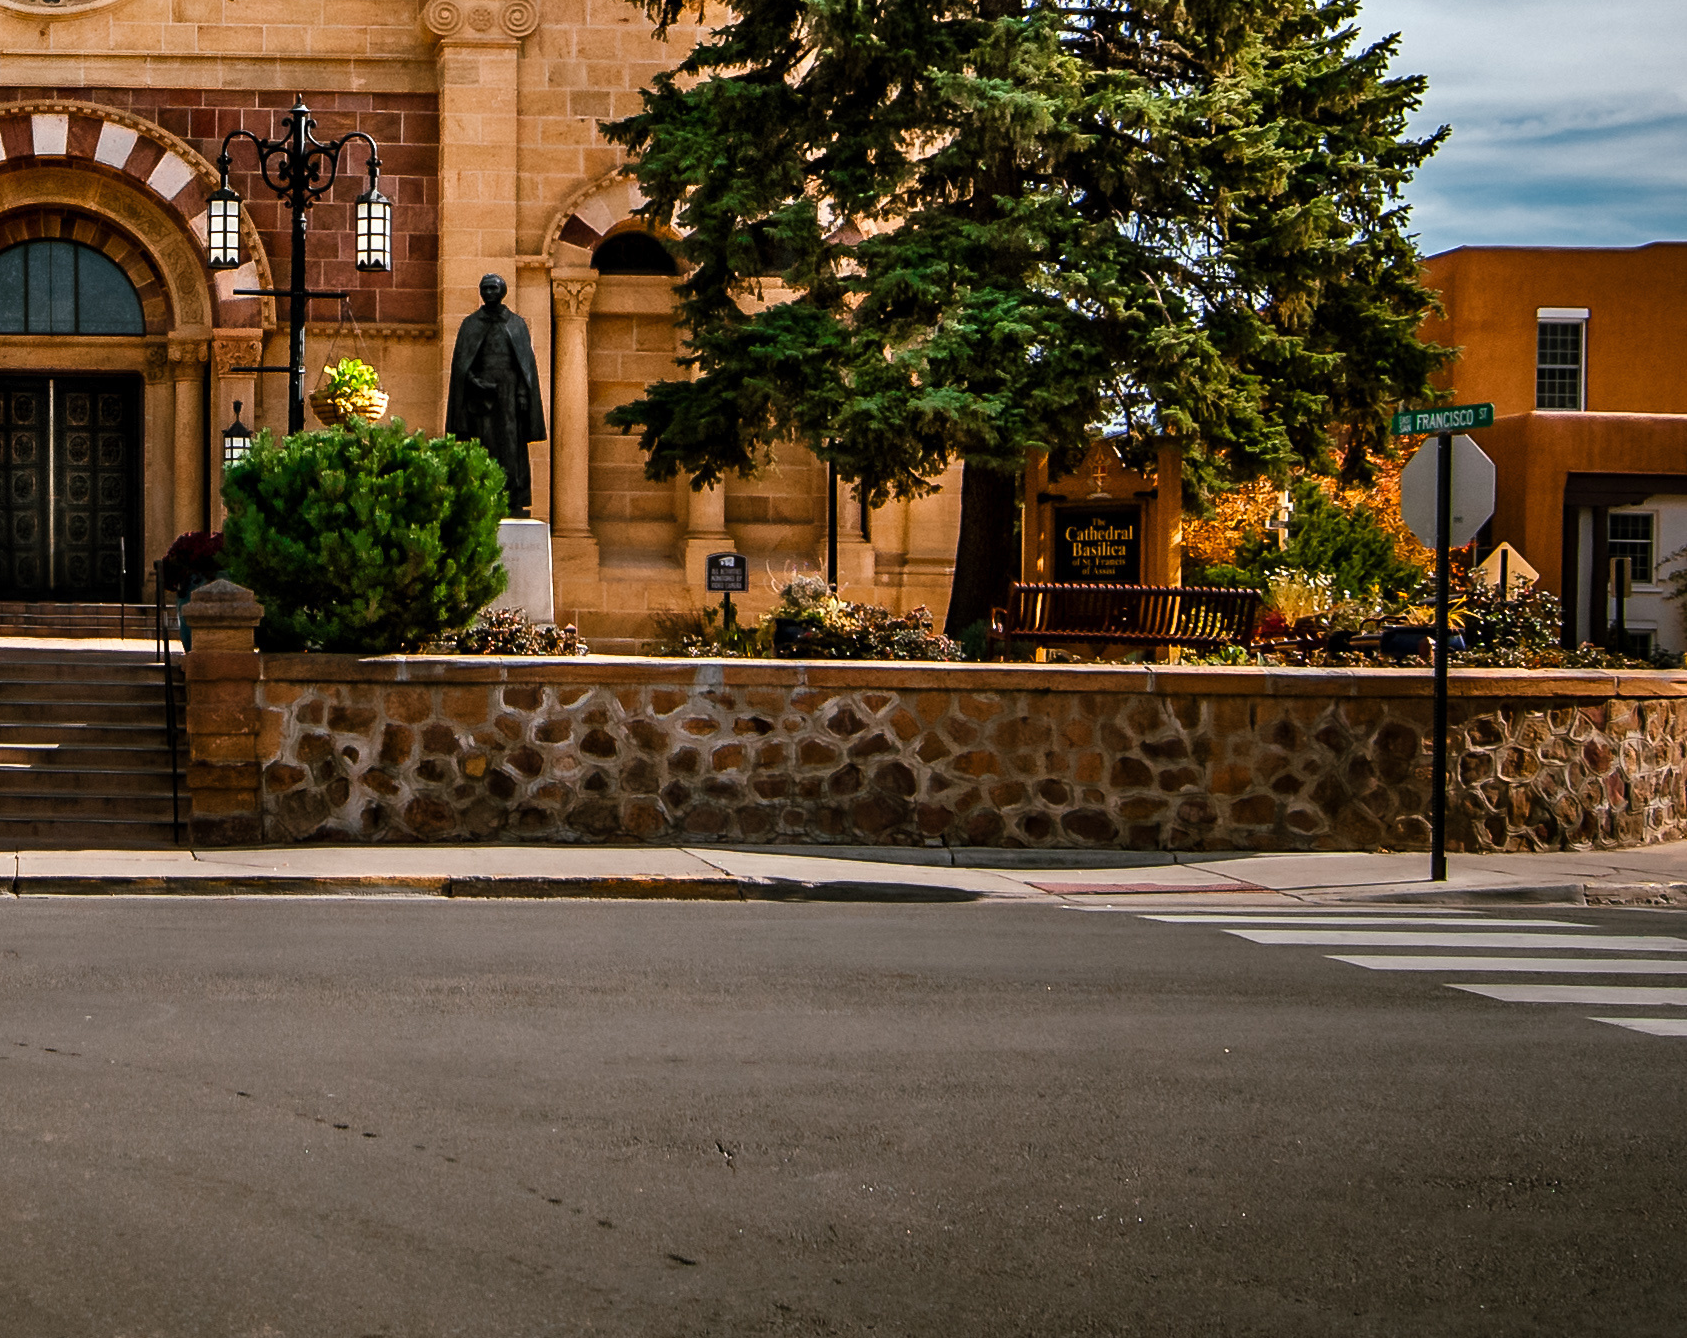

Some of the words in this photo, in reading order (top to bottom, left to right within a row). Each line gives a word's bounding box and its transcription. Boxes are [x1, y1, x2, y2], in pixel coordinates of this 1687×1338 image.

[1416, 409, 1474, 430] FRANCISCO
[1478, 407, 1488, 419] ST
[1399, 424, 1412, 433] SAN
[1093, 517, 1106, 526] The
[1065, 525, 1133, 541] Cathedral
[1072, 541, 1126, 556] Basilica
[1071, 557, 1081, 566] of
[1095, 557, 1126, 566] Francis
[1081, 566, 1090, 575] of
[1093, 566, 1116, 575] Assisi
